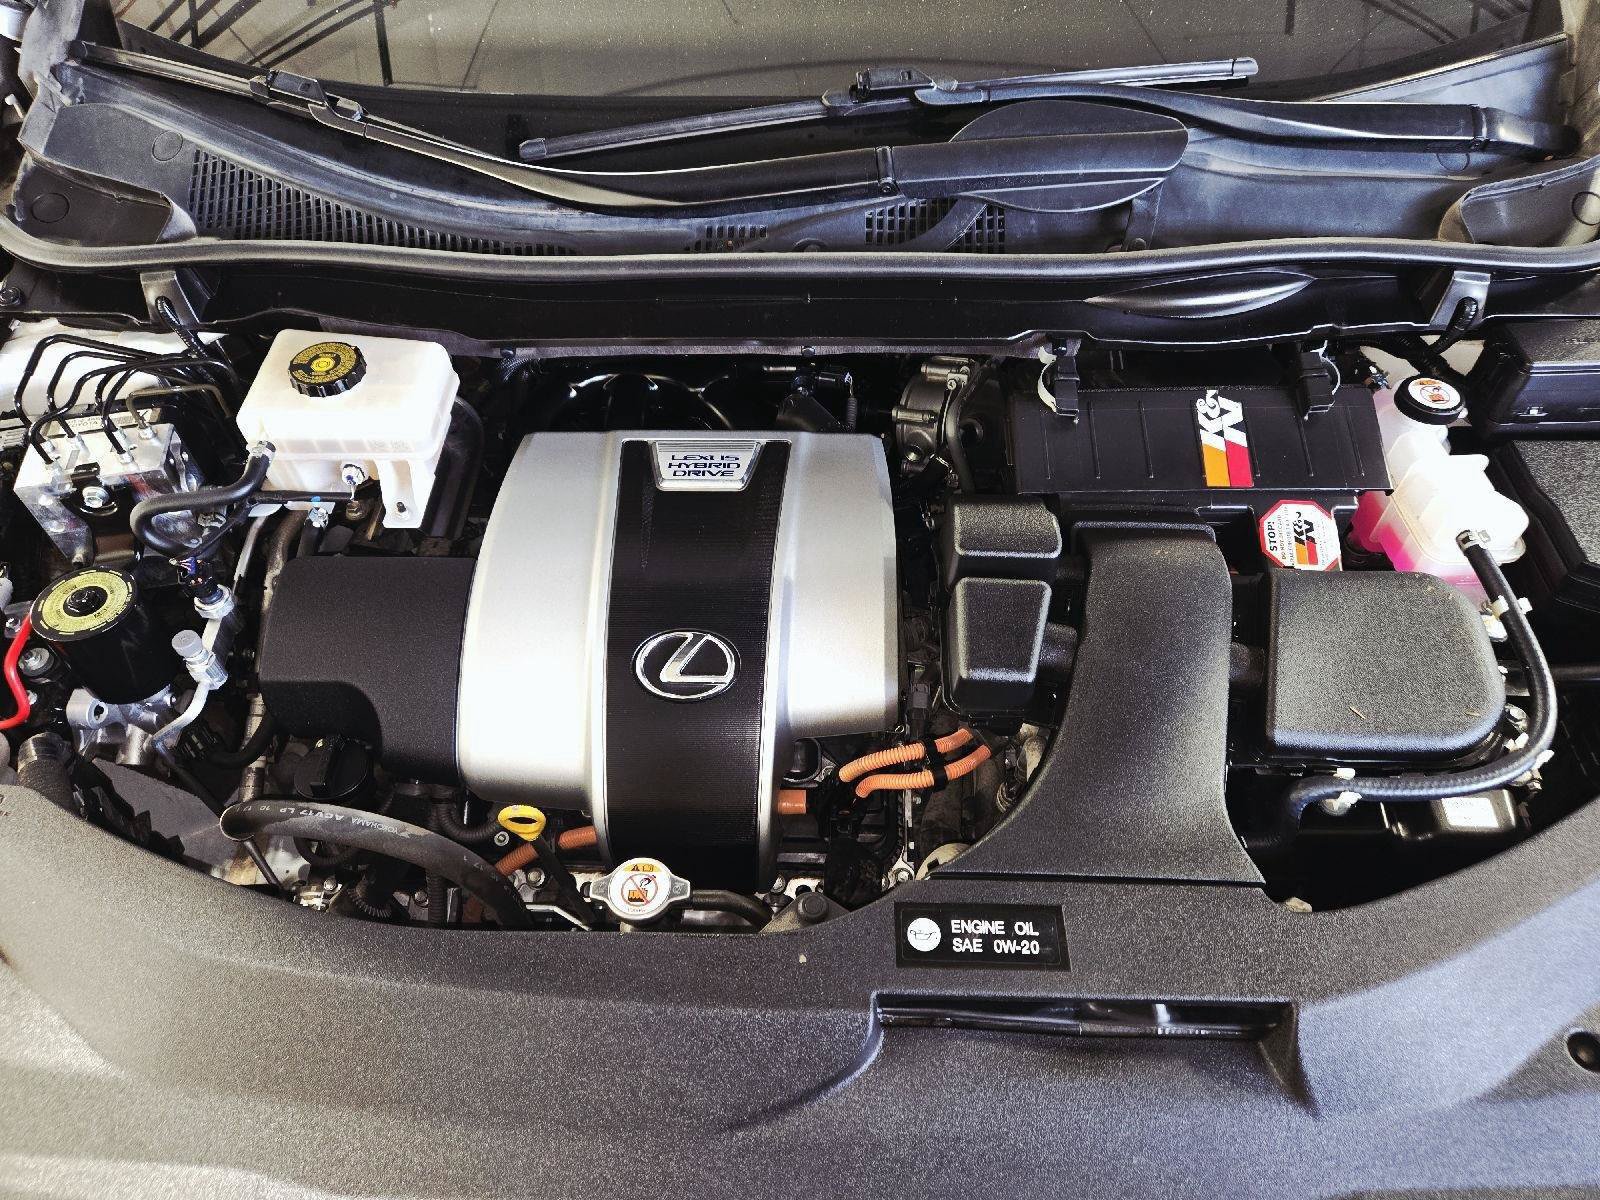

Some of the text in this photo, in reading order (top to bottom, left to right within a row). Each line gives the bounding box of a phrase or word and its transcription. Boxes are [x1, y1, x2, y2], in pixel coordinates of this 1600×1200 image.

[1196, 390, 1248, 453] K&N
[1268, 521, 1278, 551] STOP!
[350, 816, 399, 835] YOKOHAMA
[950, 919, 1040, 937] ENGINE OIL
[952, 937, 1040, 955] SAE 0W-20
